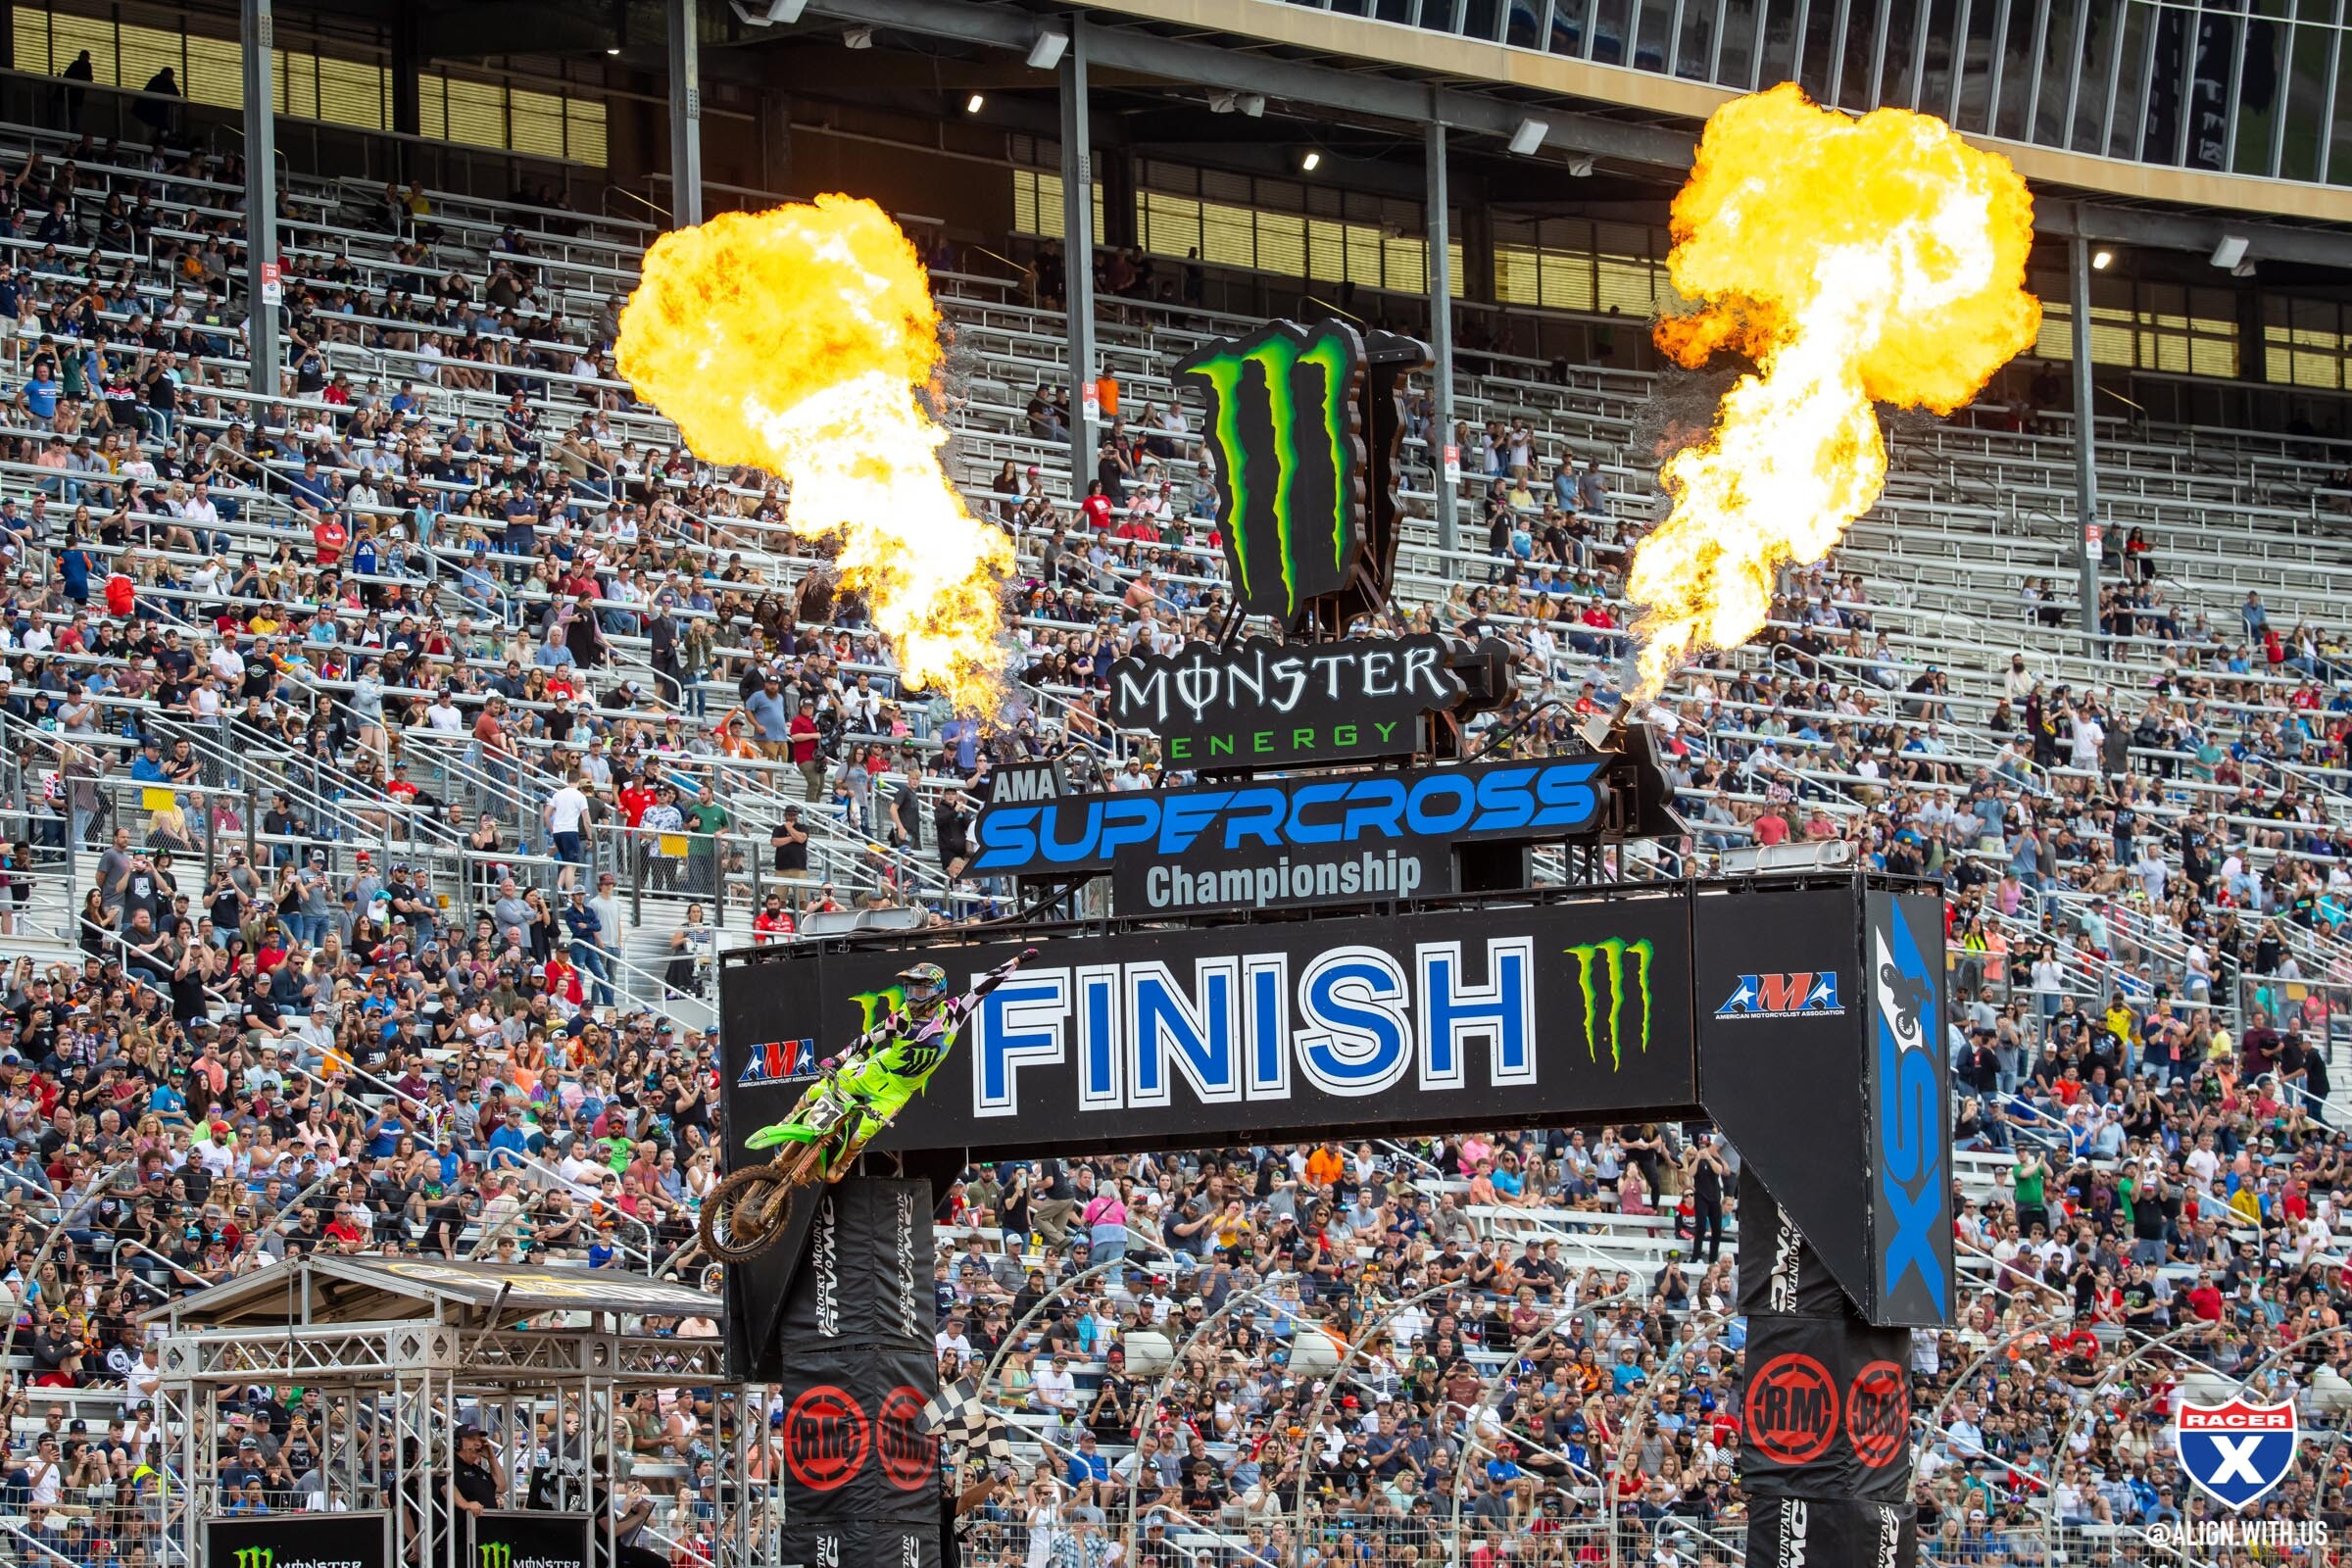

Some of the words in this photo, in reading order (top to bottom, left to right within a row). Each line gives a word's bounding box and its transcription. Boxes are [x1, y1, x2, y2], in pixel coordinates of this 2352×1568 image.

[1117, 642, 1448, 724] MONSTER
[1171, 721, 1398, 760] ENERGY
[994, 772, 1055, 804] AMA
[974, 762, 1600, 869] SUPERCROSS
[1147, 850, 1421, 907] Championship
[1714, 971, 1845, 1013] AMA
[971, 936, 1538, 1118] FINISH
[737, 1039, 820, 1082] AMA
[897, 1192, 906, 1269] MOUNTAIN
[1787, 1225, 1802, 1313] MOUNTAIN
[815, 1270, 825, 1317] ROCKY
[898, 1270, 907, 1317] ROCKY
[1765, 1386, 1822, 1433] RM
[801, 1417, 851, 1459] RM
[816, 1535, 826, 1568] TAIN
[1778, 1497, 1791, 1568] OUNTAIN
[1879, 1505, 1889, 1568] UNTAIN
